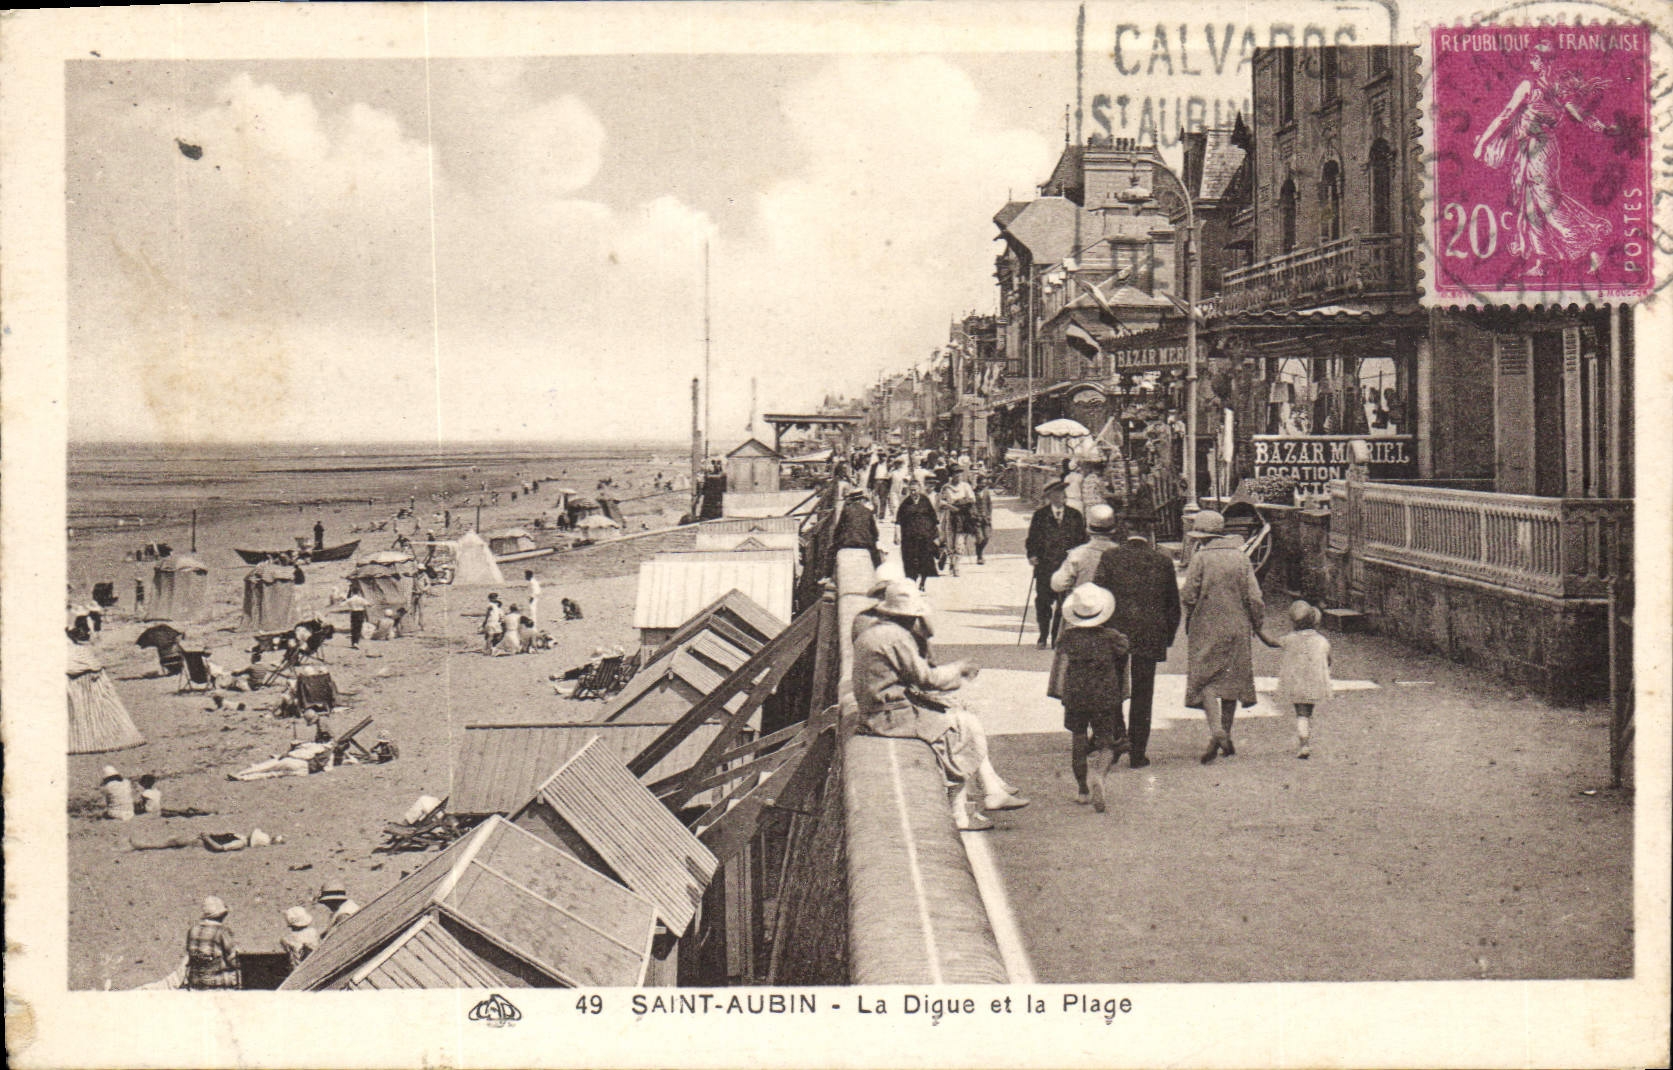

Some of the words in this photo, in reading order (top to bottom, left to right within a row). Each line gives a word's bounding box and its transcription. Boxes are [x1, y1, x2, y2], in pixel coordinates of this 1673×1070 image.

[1623, 187, 1643, 273] POSTES
[1117, 349, 1157, 367] BAZAR
[1254, 441, 1326, 464] BAZAR
[1329, 441, 1410, 464] MRIEL
[1254, 466, 1341, 481] LOCATION
